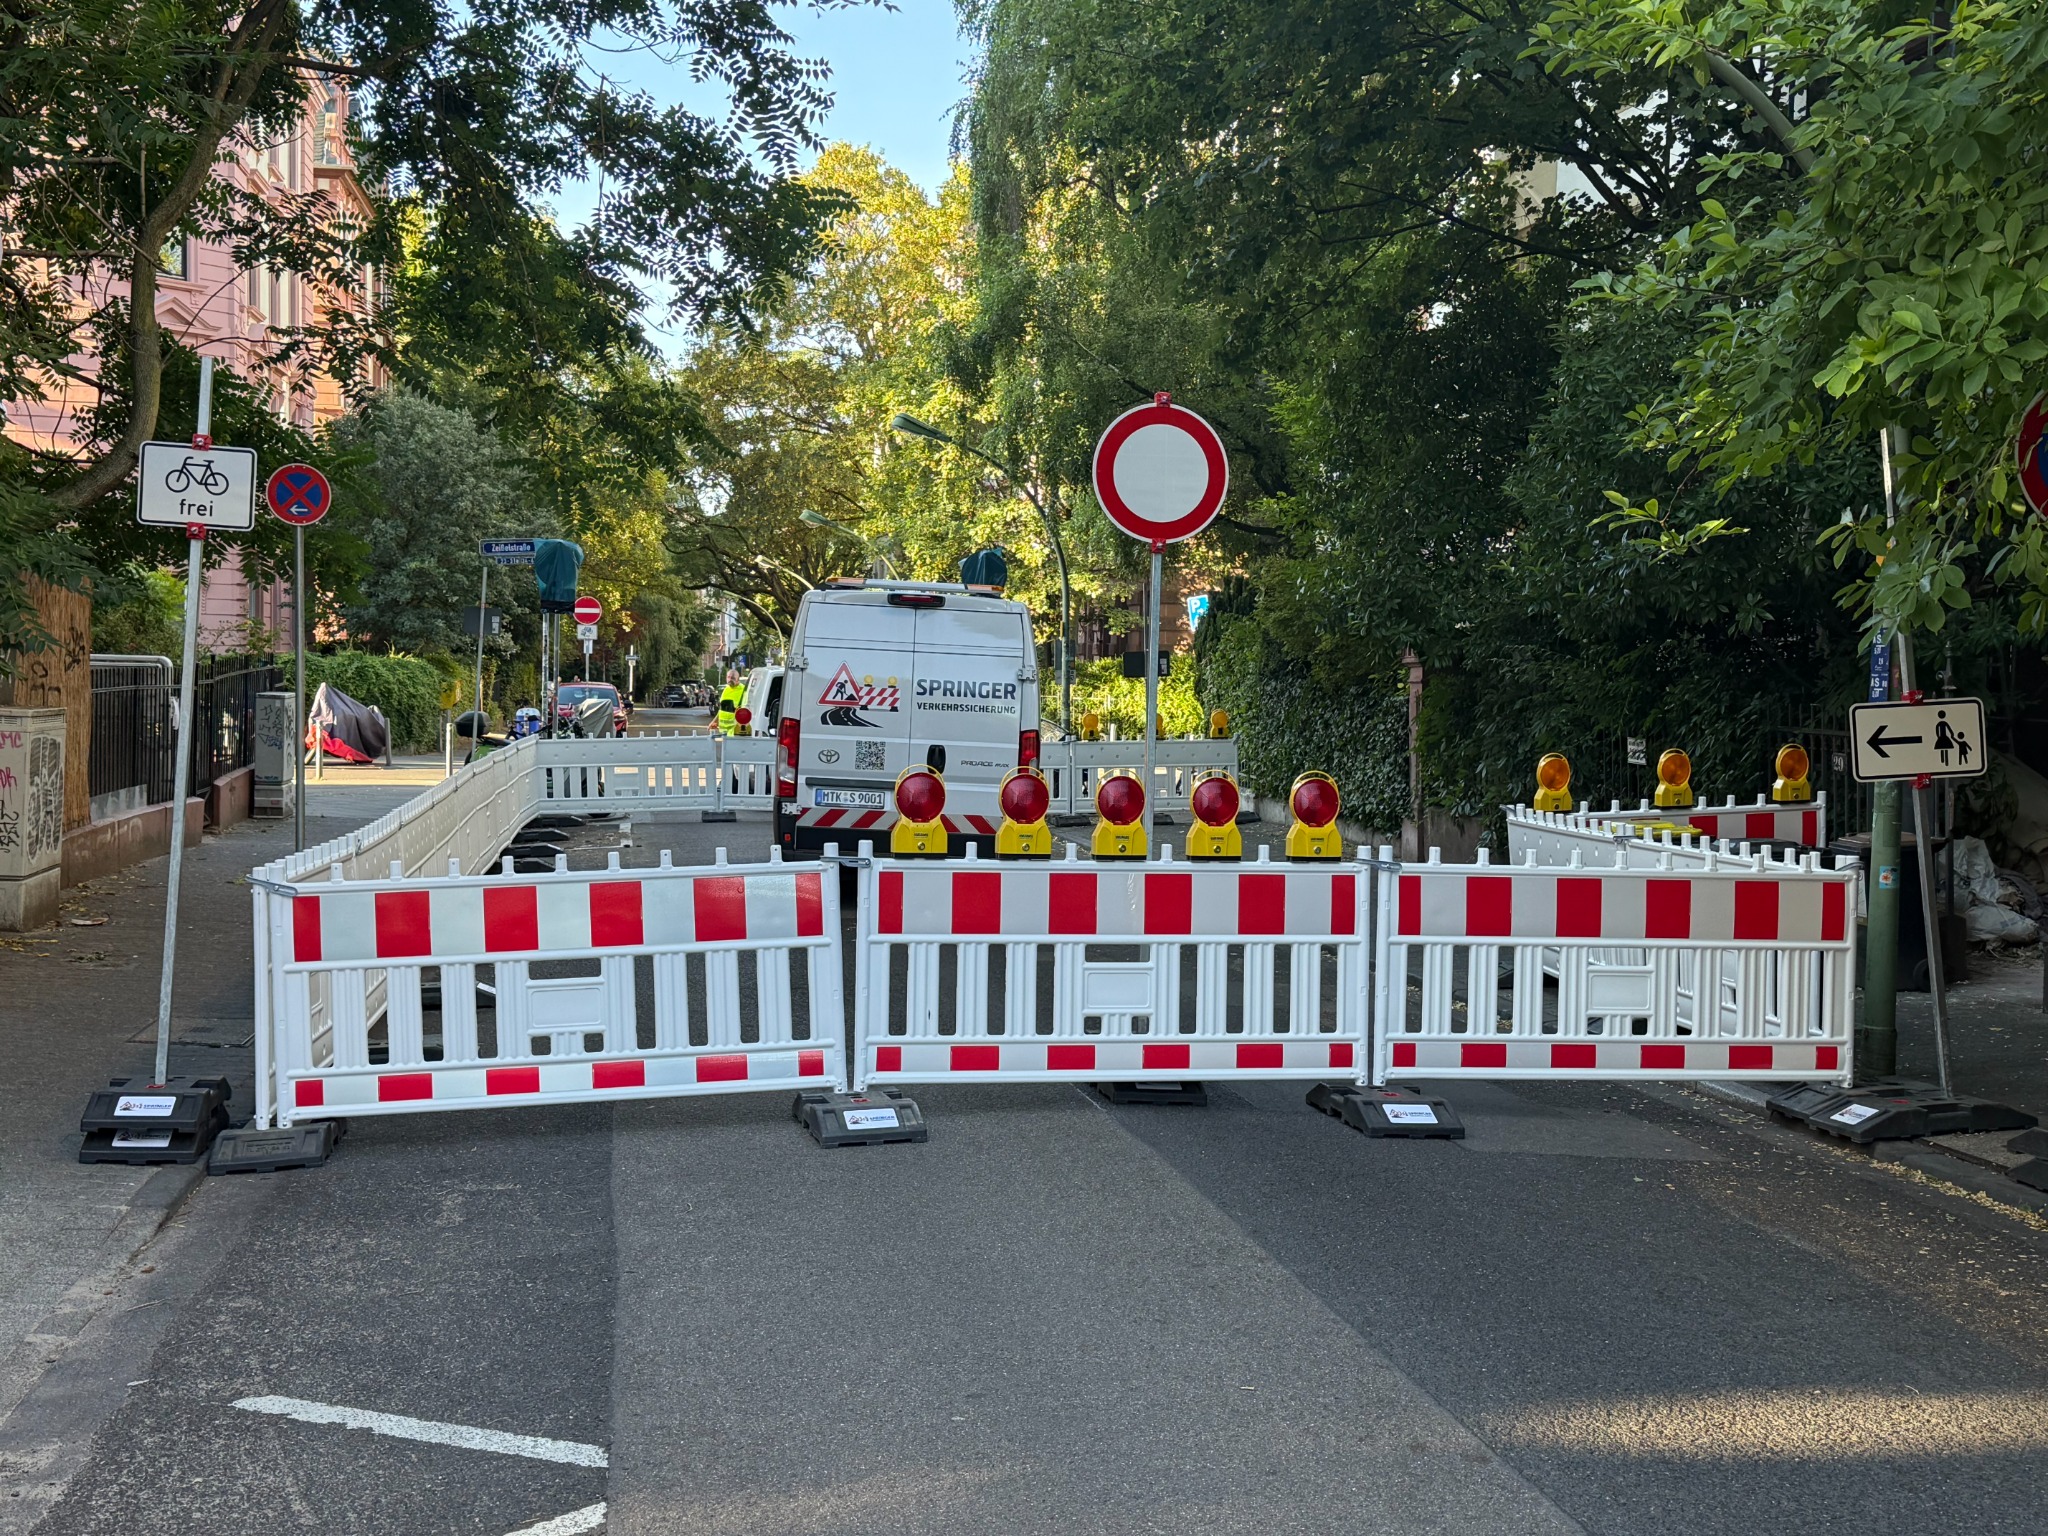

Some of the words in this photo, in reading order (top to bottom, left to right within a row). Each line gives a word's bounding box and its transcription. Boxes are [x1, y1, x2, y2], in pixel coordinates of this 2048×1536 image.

[179, 498, 214, 517] frei
[491, 543, 531, 552] Zeißelstraße
[916, 678, 1017, 700] SPRINGER
[916, 701, 1016, 714] VERKEHRSSICHERUNG
[822, 791, 842, 803] MTK
[849, 792, 856, 803] S
[858, 793, 883, 805] 9001
